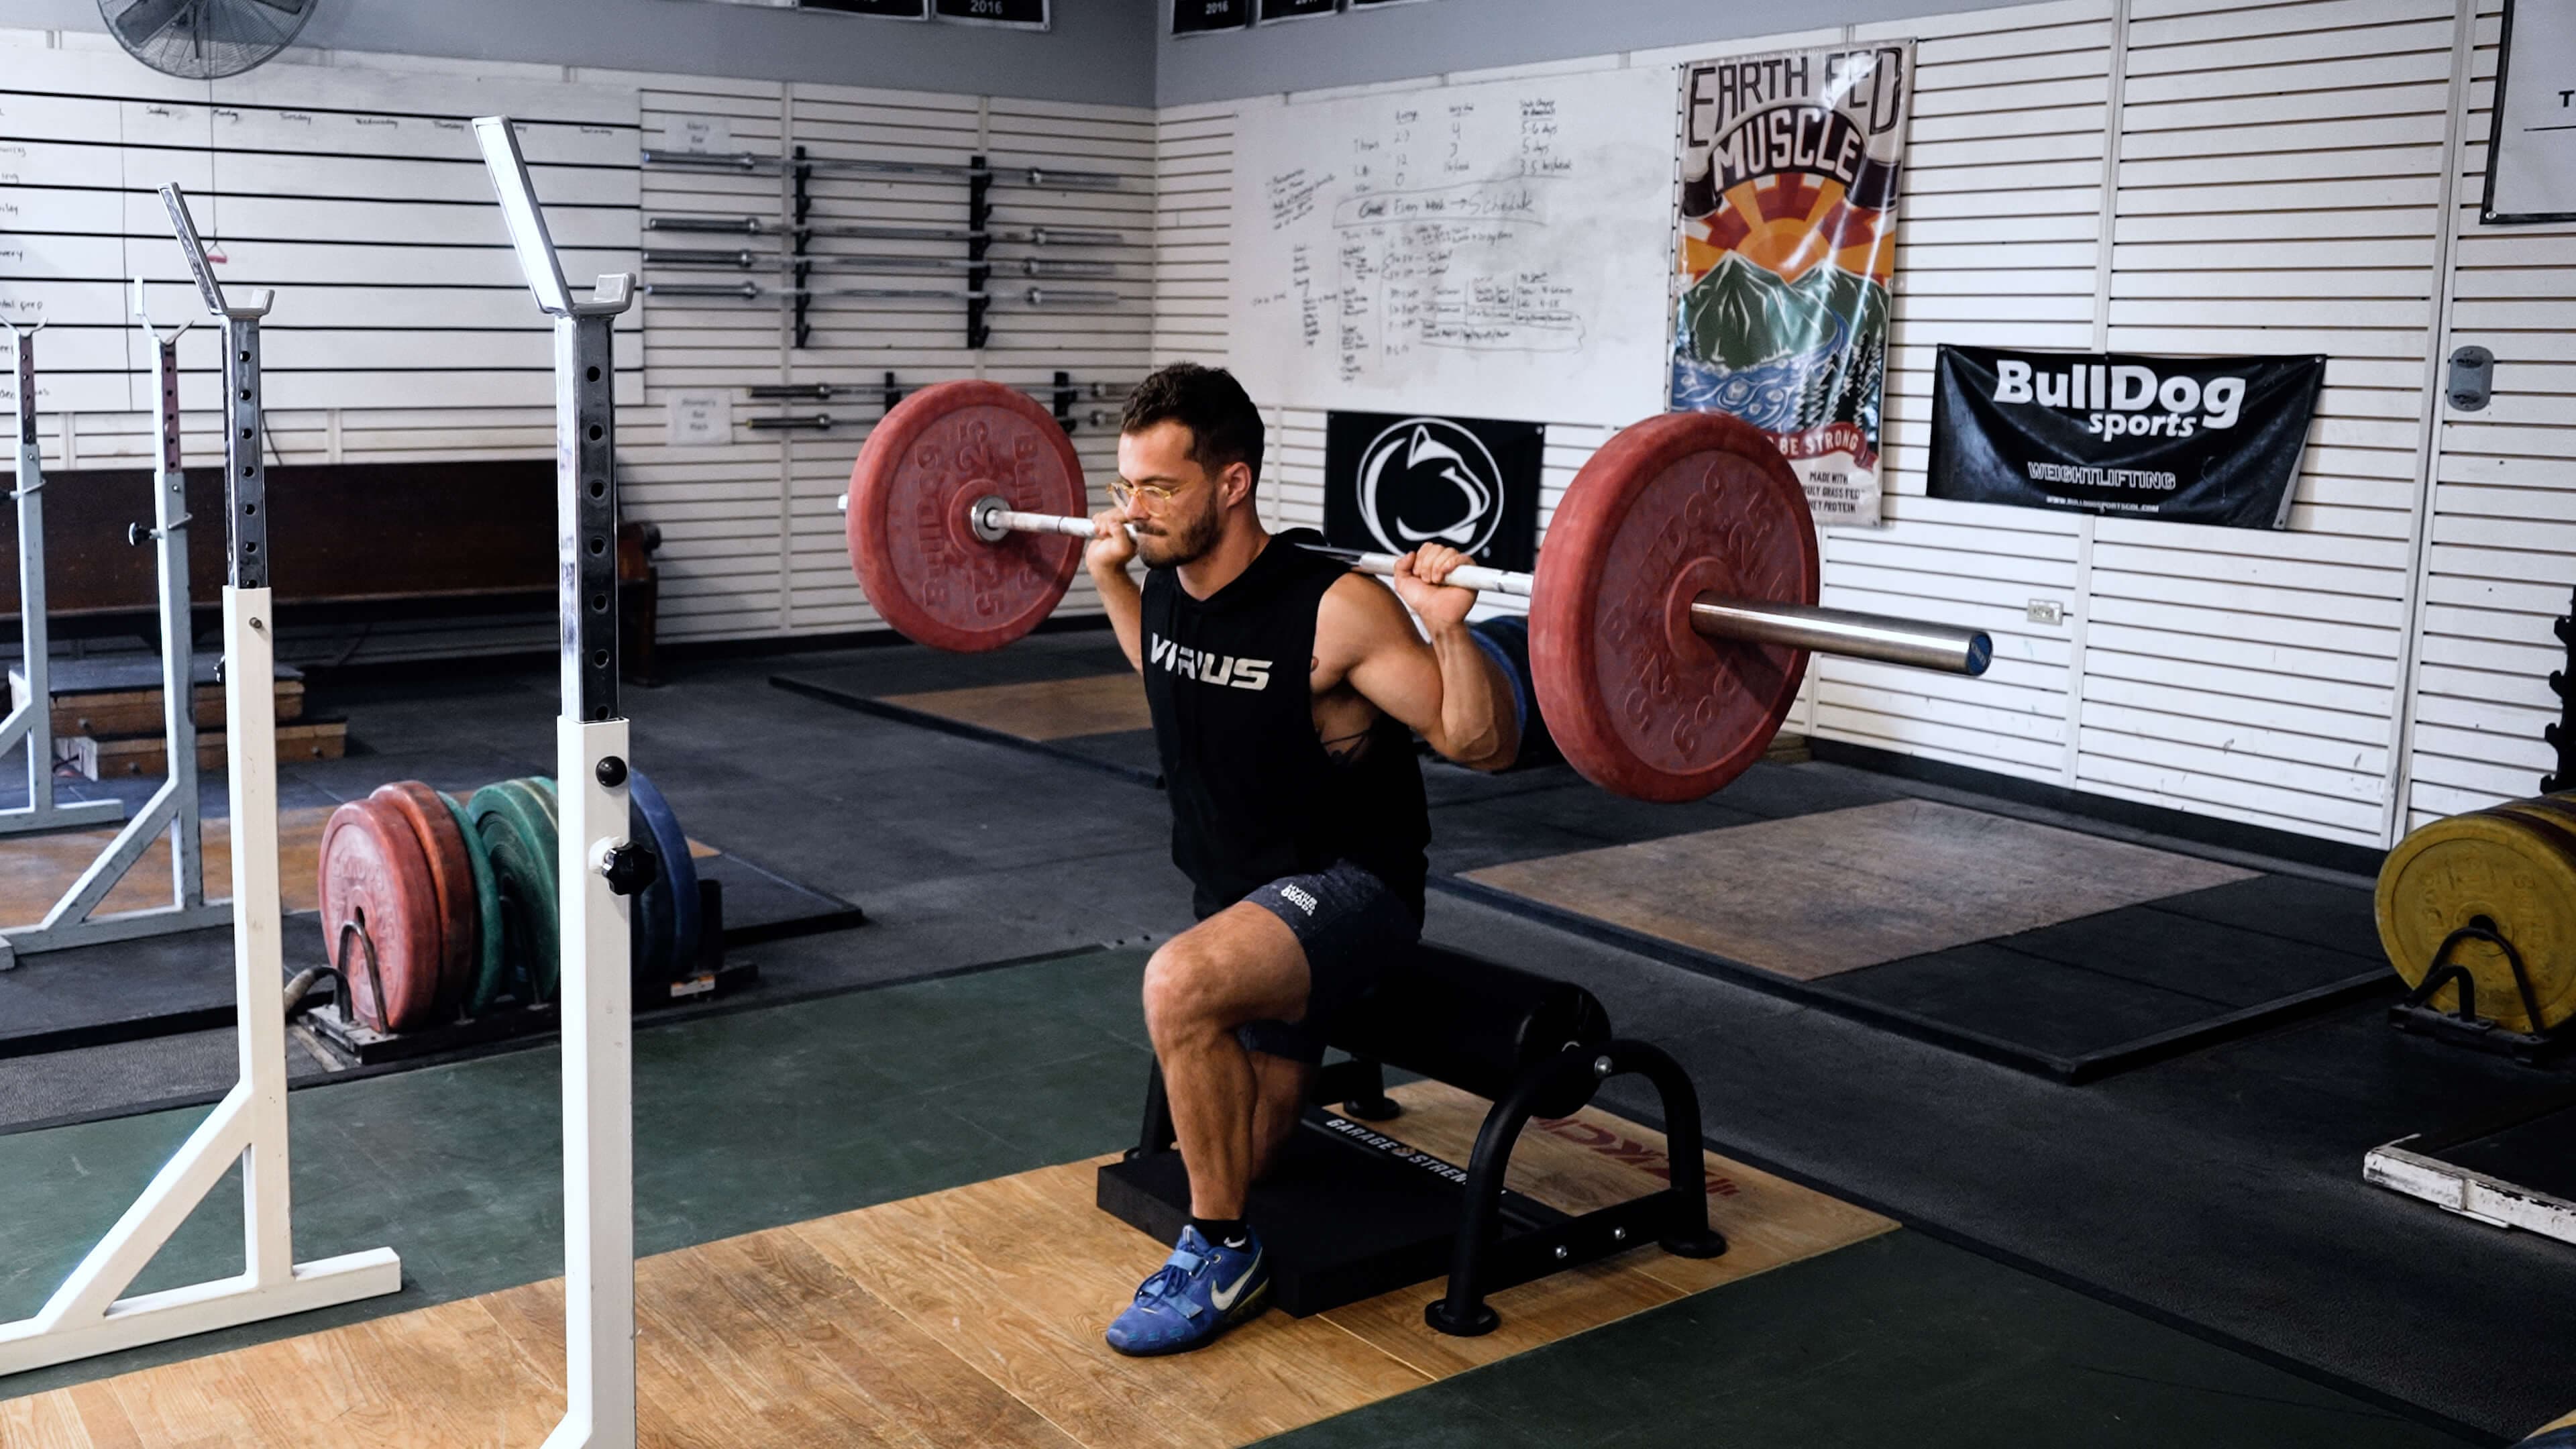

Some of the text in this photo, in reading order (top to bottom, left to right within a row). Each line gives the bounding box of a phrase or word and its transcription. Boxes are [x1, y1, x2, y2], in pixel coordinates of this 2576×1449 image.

[970, 0, 1003, 14] 2016
[1205, 1, 1229, 15] 2016
[1688, 57, 1809, 148] EARTH
[2558, 90, 2576, 107] T
[1713, 107, 1866, 190] MUSCLE
[1992, 359, 2247, 429] BullDog
[2088, 411, 2196, 442] sports
[1779, 429, 1860, 455] BE STRONG
[1810, 472, 1849, 484] MADE WITH
[2027, 461, 2176, 490] WEIGHTLIFTING
[1822, 486, 1844, 498] GRASS
[1823, 501, 1856, 514] PROTEIN
[1150, 632, 1273, 691] VIRUS
[1326, 1118, 1467, 1185] GARAGE STREN
